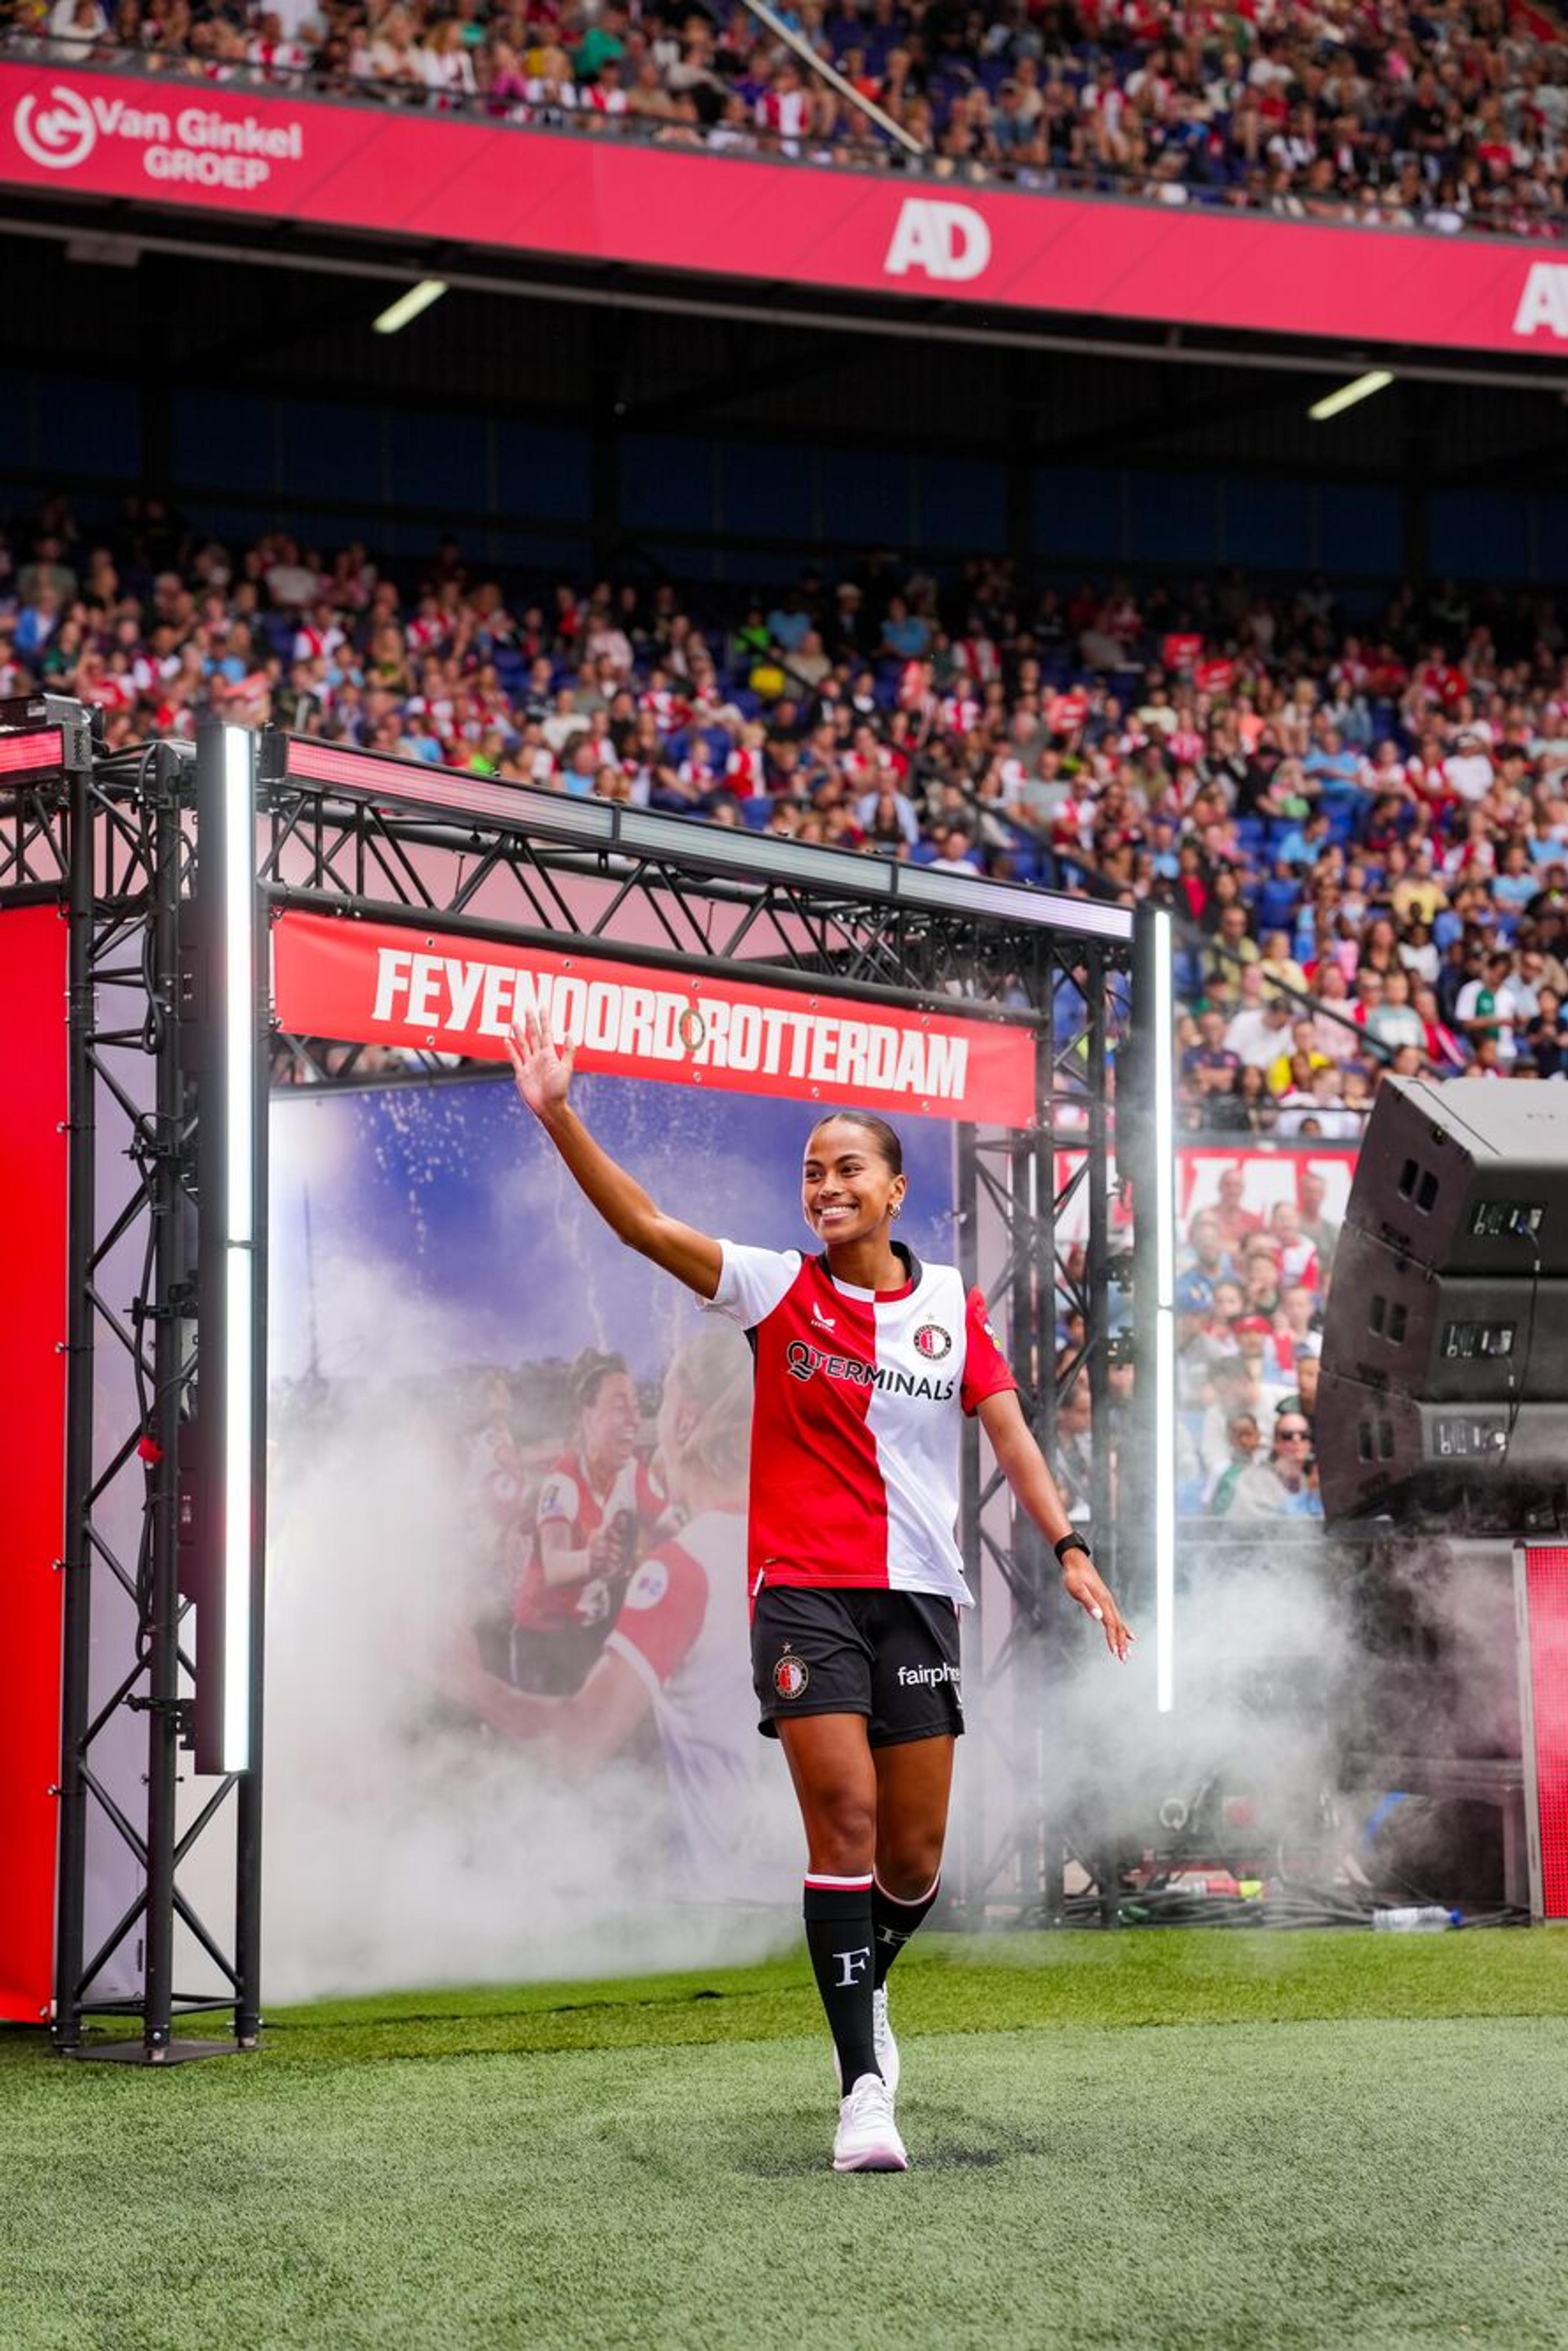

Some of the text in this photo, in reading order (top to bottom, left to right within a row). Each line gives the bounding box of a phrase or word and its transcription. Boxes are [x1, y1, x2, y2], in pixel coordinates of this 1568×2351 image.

[91, 97, 303, 158] Van Ginkel
[143, 145, 270, 189] GROEP
[883, 197, 992, 281] AD
[1512, 261, 1568, 338] A
[372, 948, 969, 1100] FEYENOORD ROTTERDAM
[898, 1662, 960, 1687] fairph
[833, 1947, 871, 1987] F
